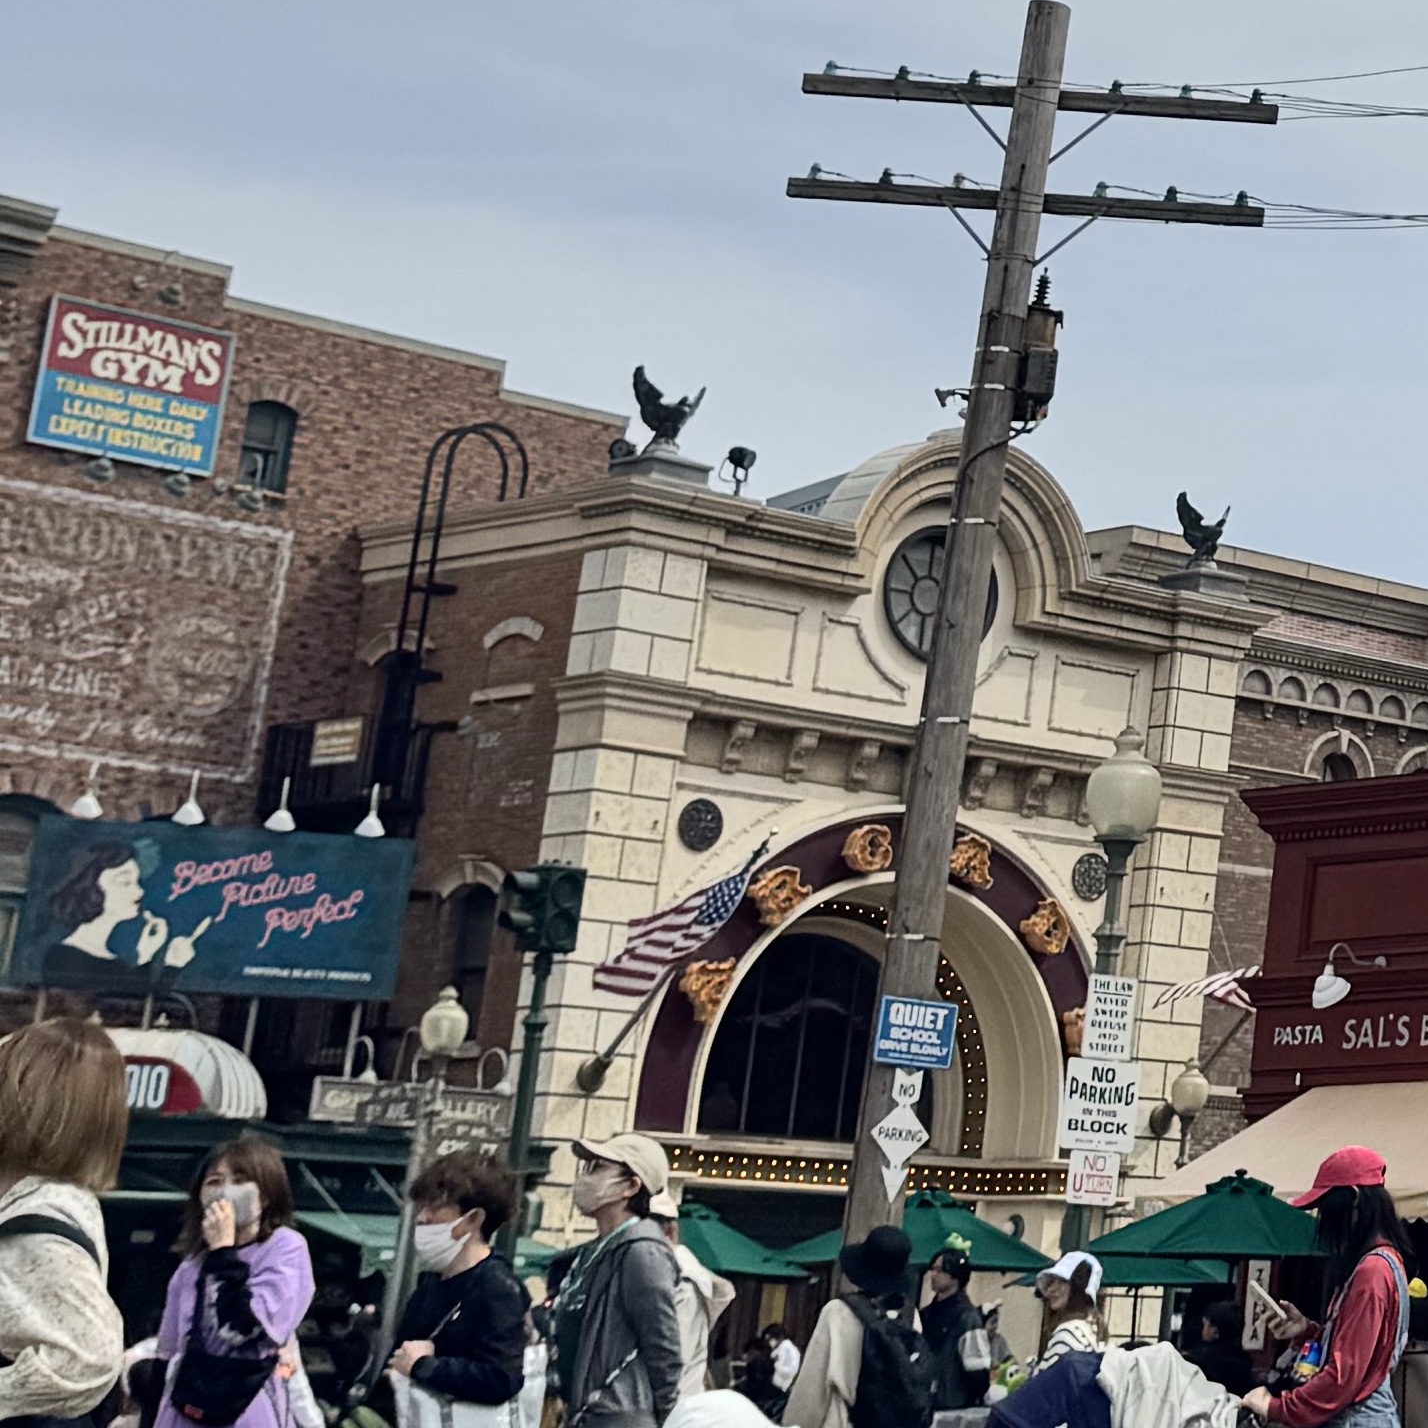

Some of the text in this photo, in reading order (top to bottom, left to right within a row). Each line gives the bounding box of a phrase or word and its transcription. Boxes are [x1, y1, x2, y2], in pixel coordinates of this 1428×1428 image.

[57, 312, 222, 386] STILLMAN'S
[91, 349, 186, 393] GYM
[167, 850, 275, 902] Become
[214, 873, 317, 923] Picture
[256, 890, 365, 949] Perfect
[1094, 978, 1110, 990] THE
[1096, 996, 1128, 1007] NEVER
[889, 1002, 949, 1030] QUIET
[1094, 1008, 1127, 1018] SWEEP
[1091, 1019, 1127, 1031] REFUSE
[1273, 1024, 1324, 1046] PASTA
[1342, 1012, 1410, 1050] SAL'S
[890, 1026, 941, 1045] SCHOOL
[879, 1039, 908, 1052] DRIVE
[910, 1043, 949, 1057] SLOWLY
[1089, 1042, 1124, 1053] STREET
[1091, 1066, 1116, 1084] NO
[898, 1083, 915, 1098] NO
[1069, 1076, 1135, 1106] PARKING
[1096, 1108, 1117, 1118] THIS
[878, 1126, 923, 1143] PARKING
[1068, 1118, 1128, 1135] BLOCK
[1083, 1155, 1107, 1172] NO
[1073, 1172, 1083, 1193] U
